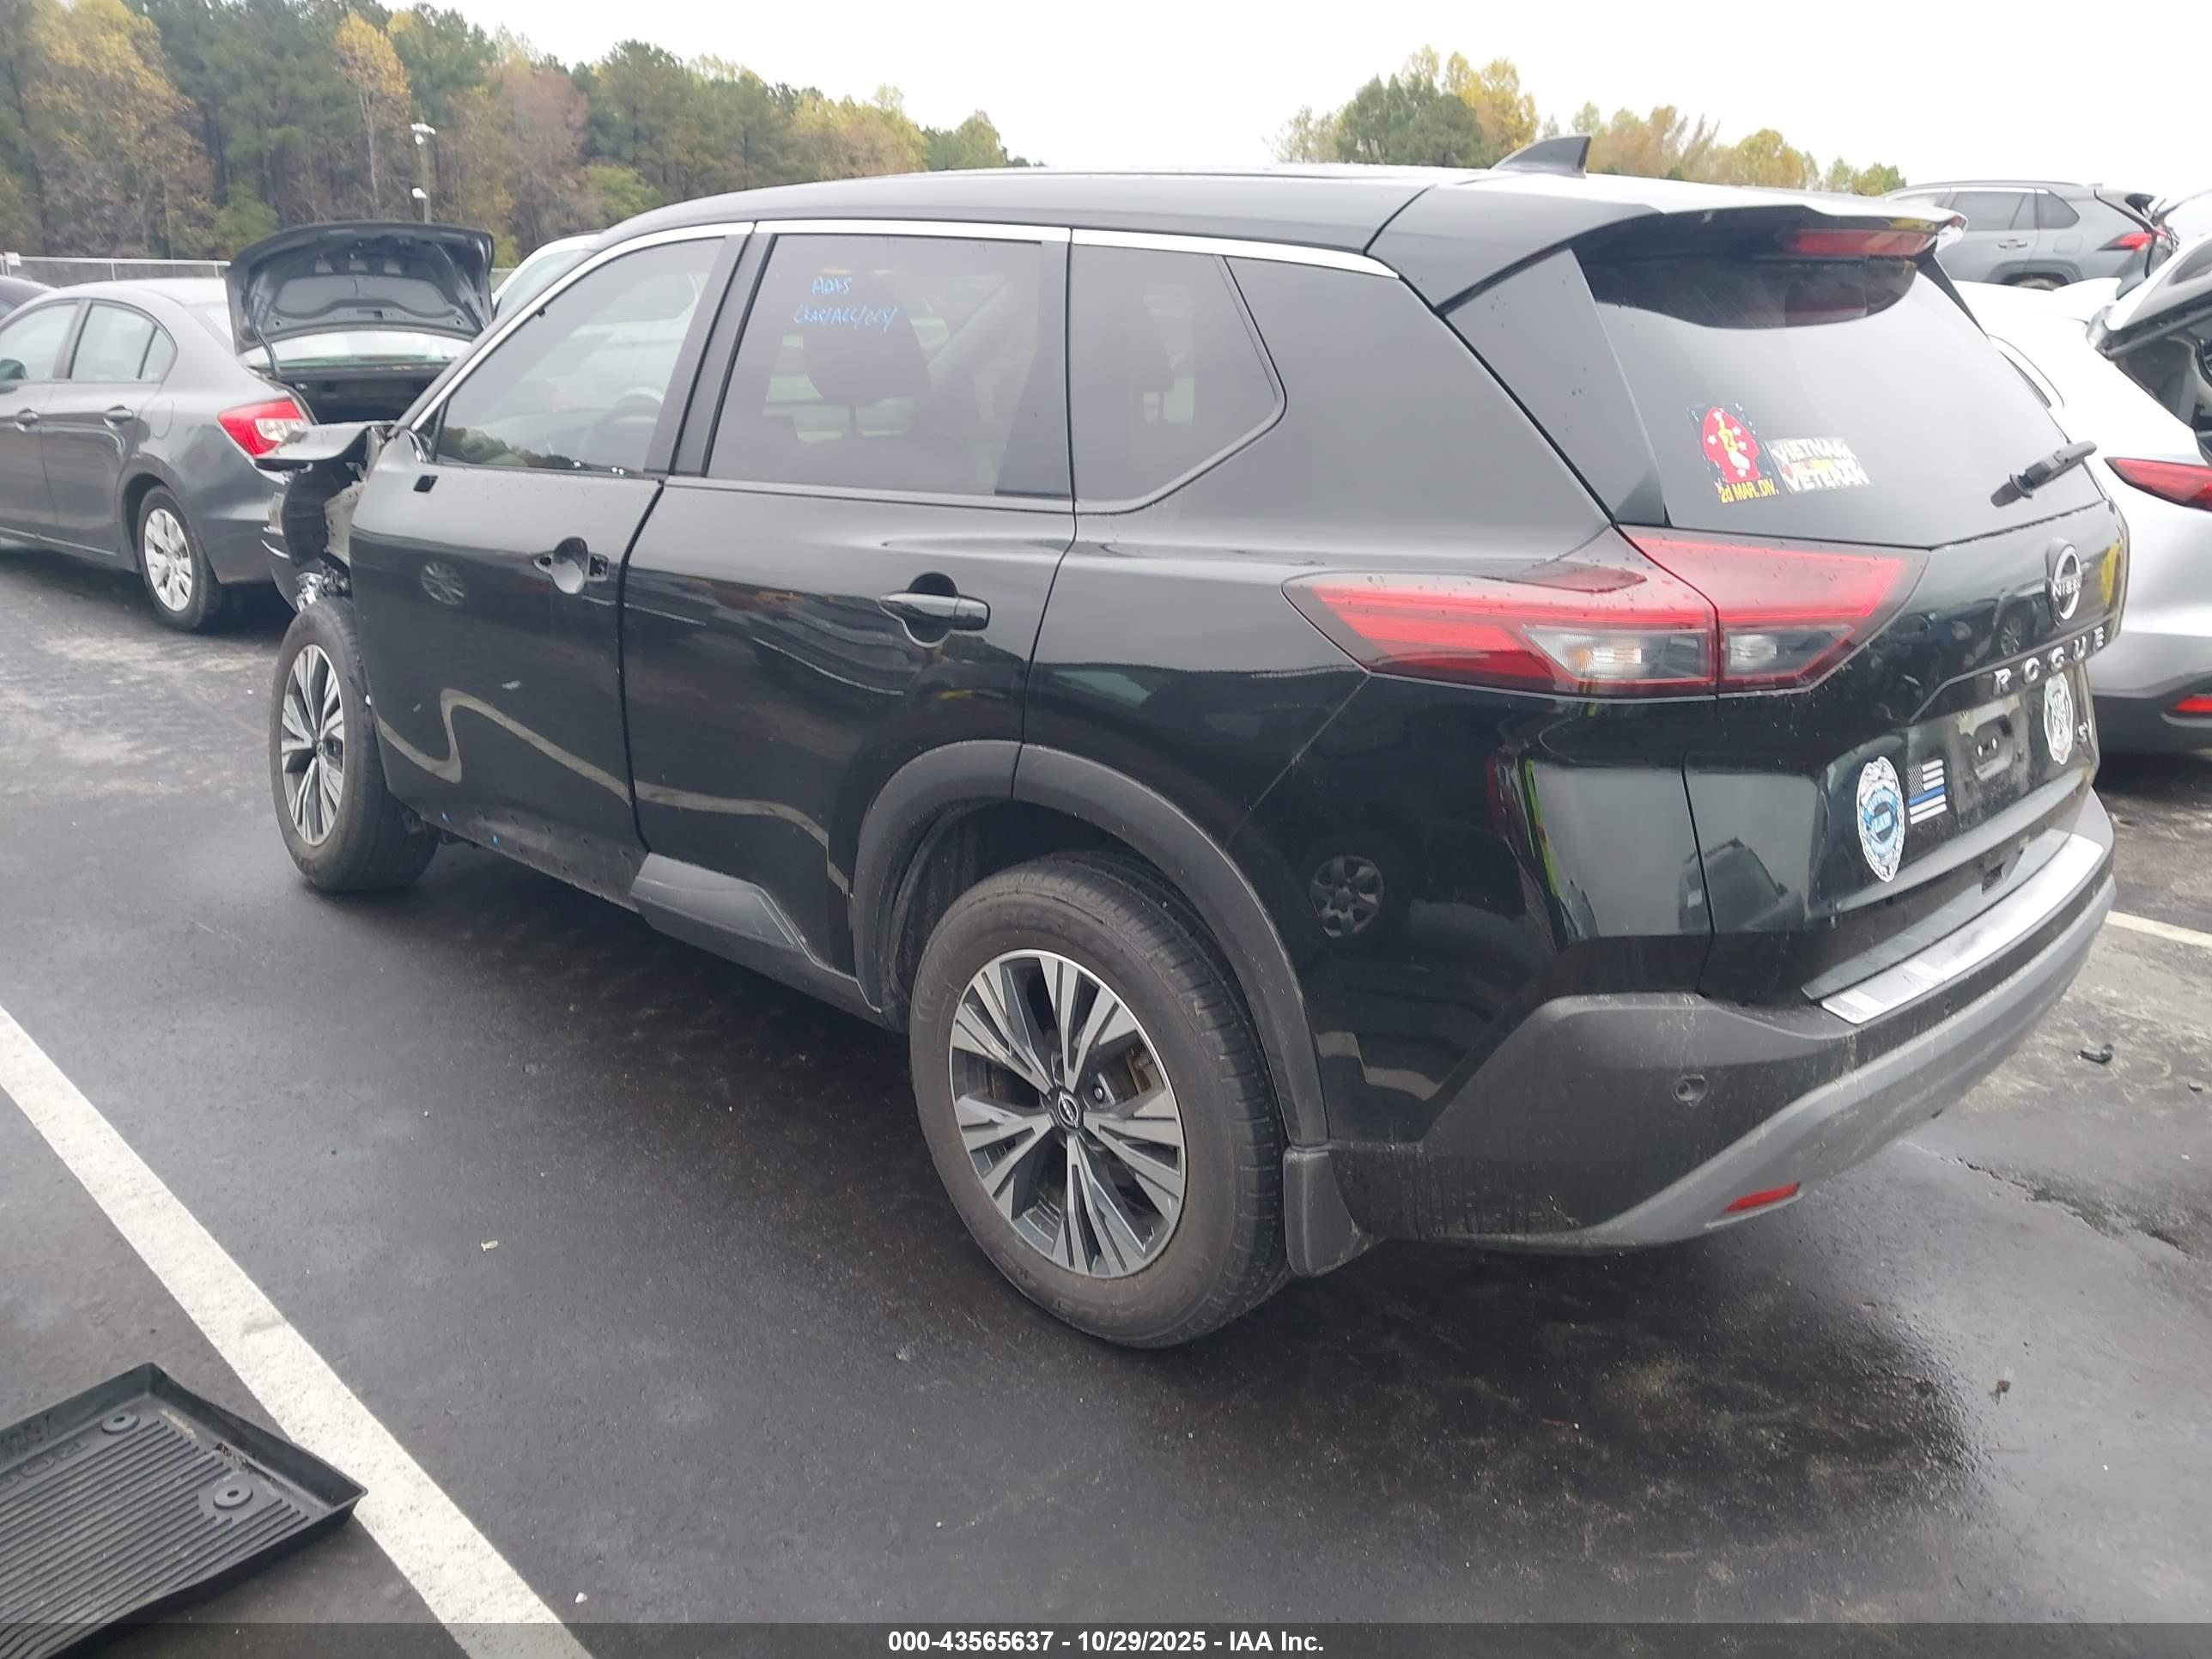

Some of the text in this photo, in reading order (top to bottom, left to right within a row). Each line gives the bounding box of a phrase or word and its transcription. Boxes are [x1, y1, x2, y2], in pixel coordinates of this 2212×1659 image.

[1771, 438, 1857, 464] VIETNAM
[1731, 480, 1760, 501] MAR.
[1758, 477, 1780, 497] DIV.
[1782, 465, 1870, 492] VETERAN
[1992, 625, 2105, 696] ROGUE
